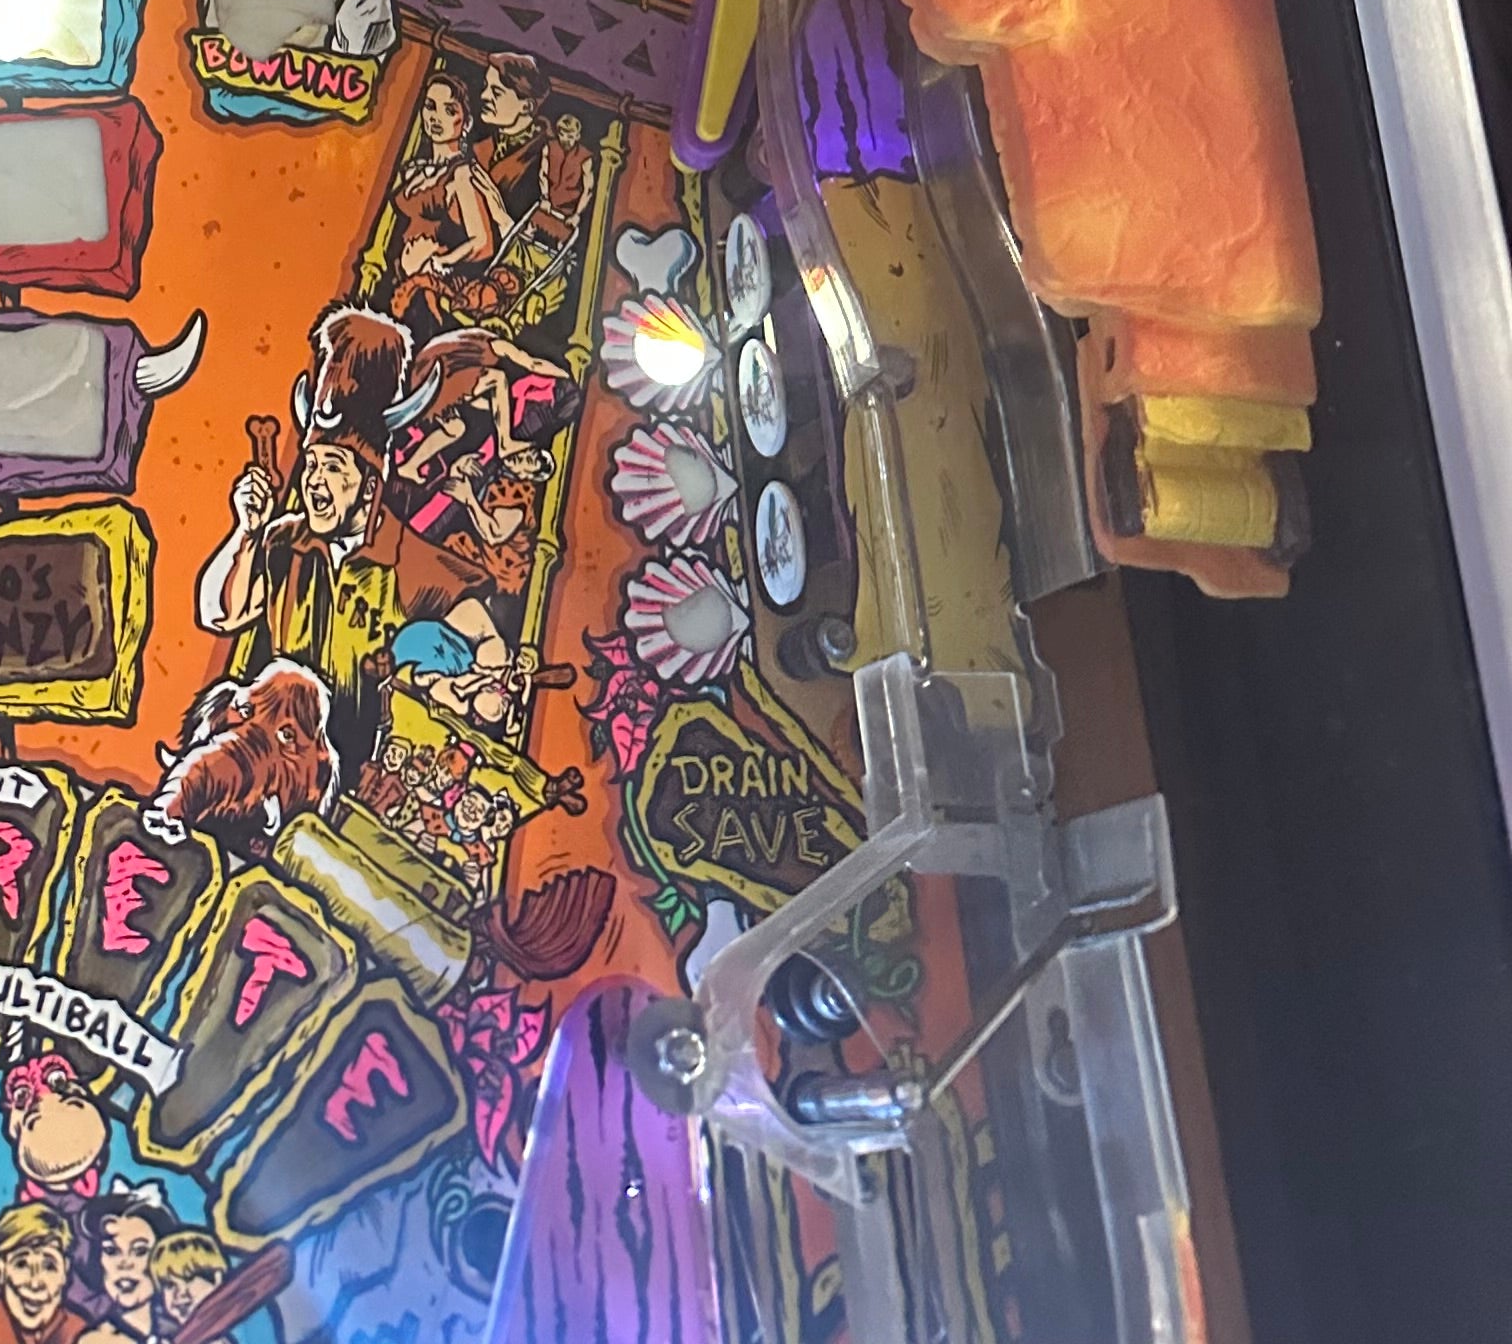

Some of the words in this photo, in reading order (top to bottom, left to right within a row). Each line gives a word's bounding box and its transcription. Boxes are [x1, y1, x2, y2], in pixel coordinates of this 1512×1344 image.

[200, 38, 369, 103] BOWLING
[671, 752, 811, 799] DRAIN
[677, 805, 829, 865] SAVE
